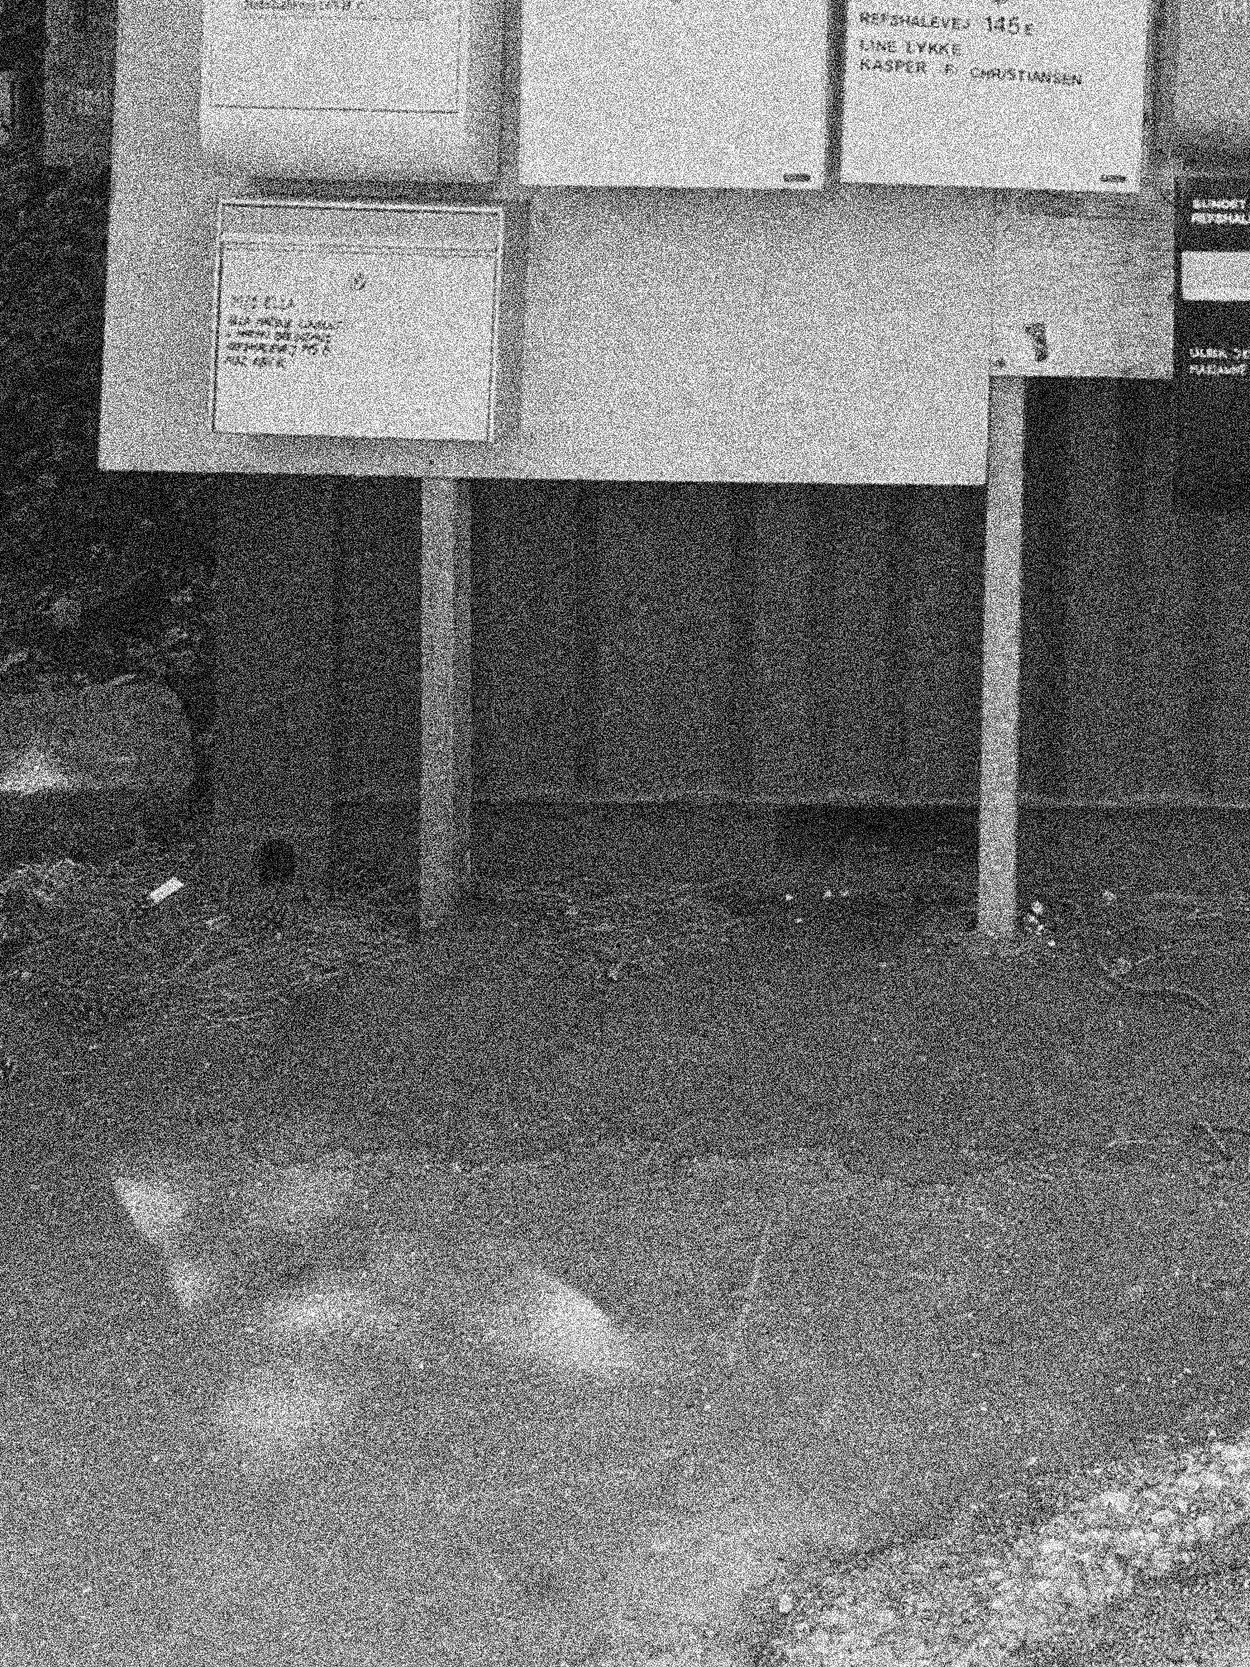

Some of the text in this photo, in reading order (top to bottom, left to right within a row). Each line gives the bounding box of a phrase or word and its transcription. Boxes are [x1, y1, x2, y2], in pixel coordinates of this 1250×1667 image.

[859, 12, 970, 30] REFSHALEVEJ
[860, 39, 961, 56] LINE LYKKE
[859, 58, 926, 73] KASPER
[969, 67, 1081, 85] CHRISTIANSEN
